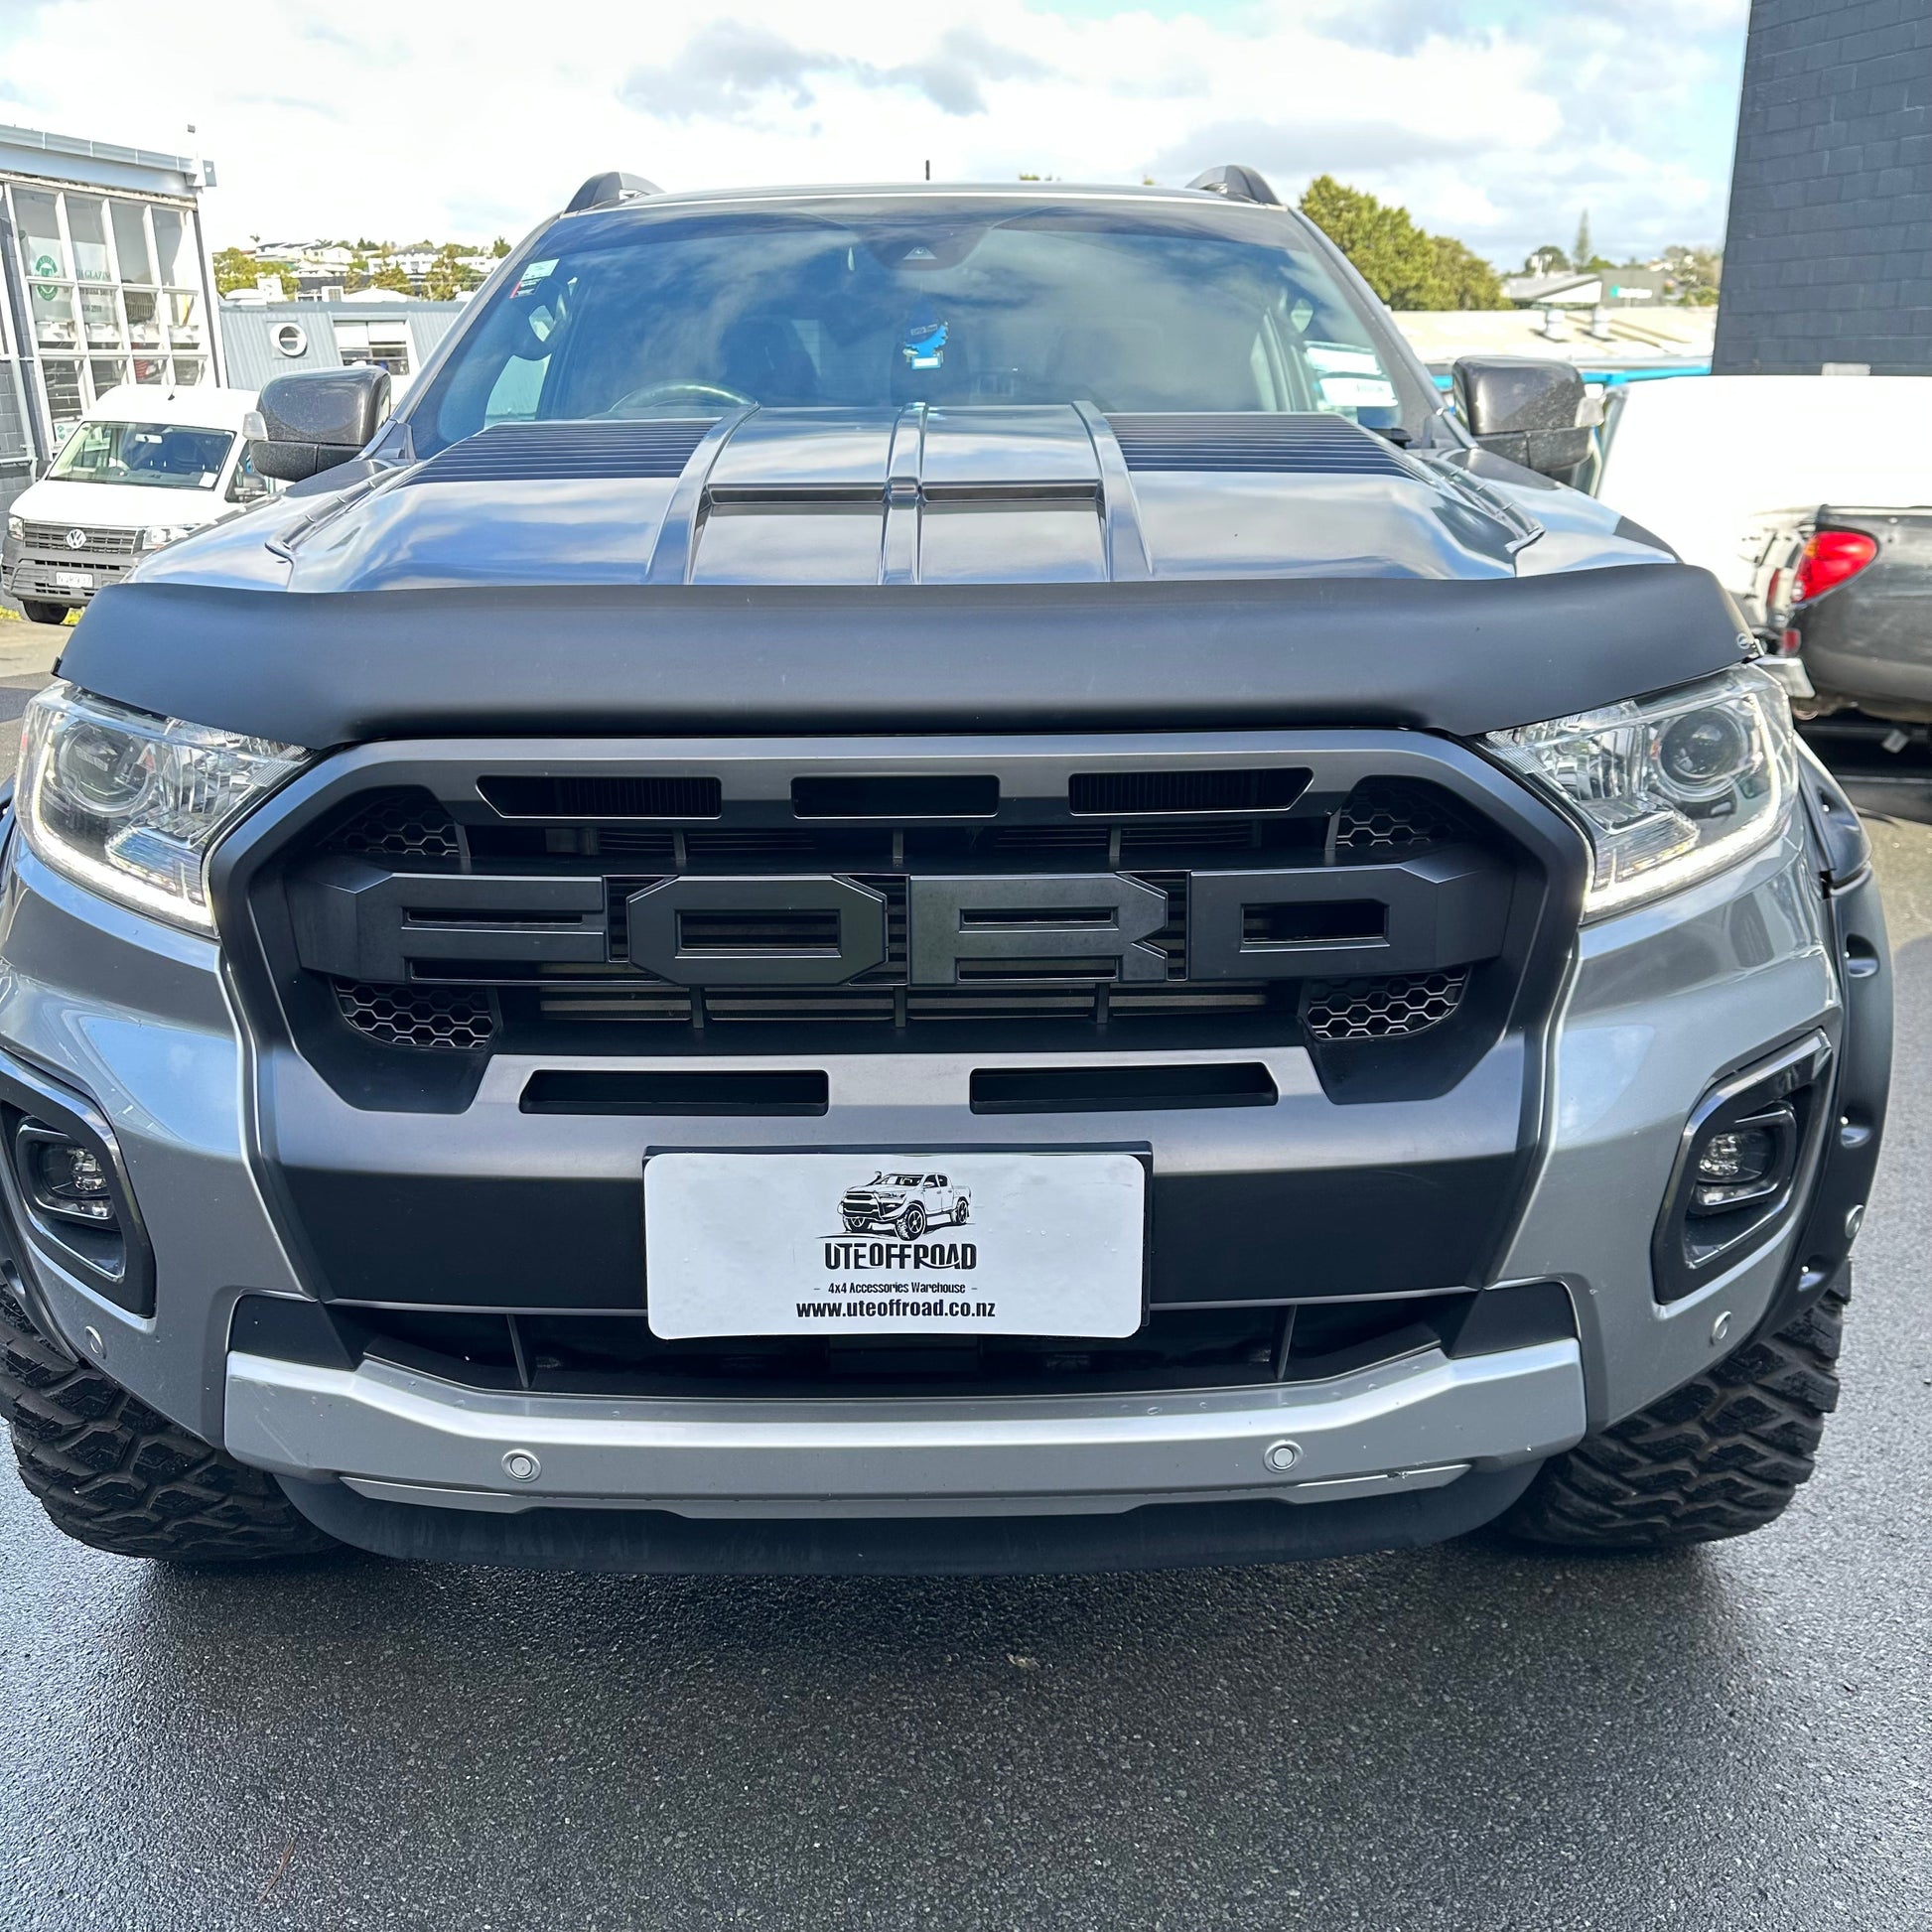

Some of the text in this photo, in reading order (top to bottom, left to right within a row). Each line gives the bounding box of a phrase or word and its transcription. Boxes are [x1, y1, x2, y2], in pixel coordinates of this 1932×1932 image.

[355, 865, 1438, 987] FORD
[828, 1281, 966, 1294] 4x4 Accessories Warehouse
[796, 1299, 996, 1317] www.uteoffroad.co.nz
